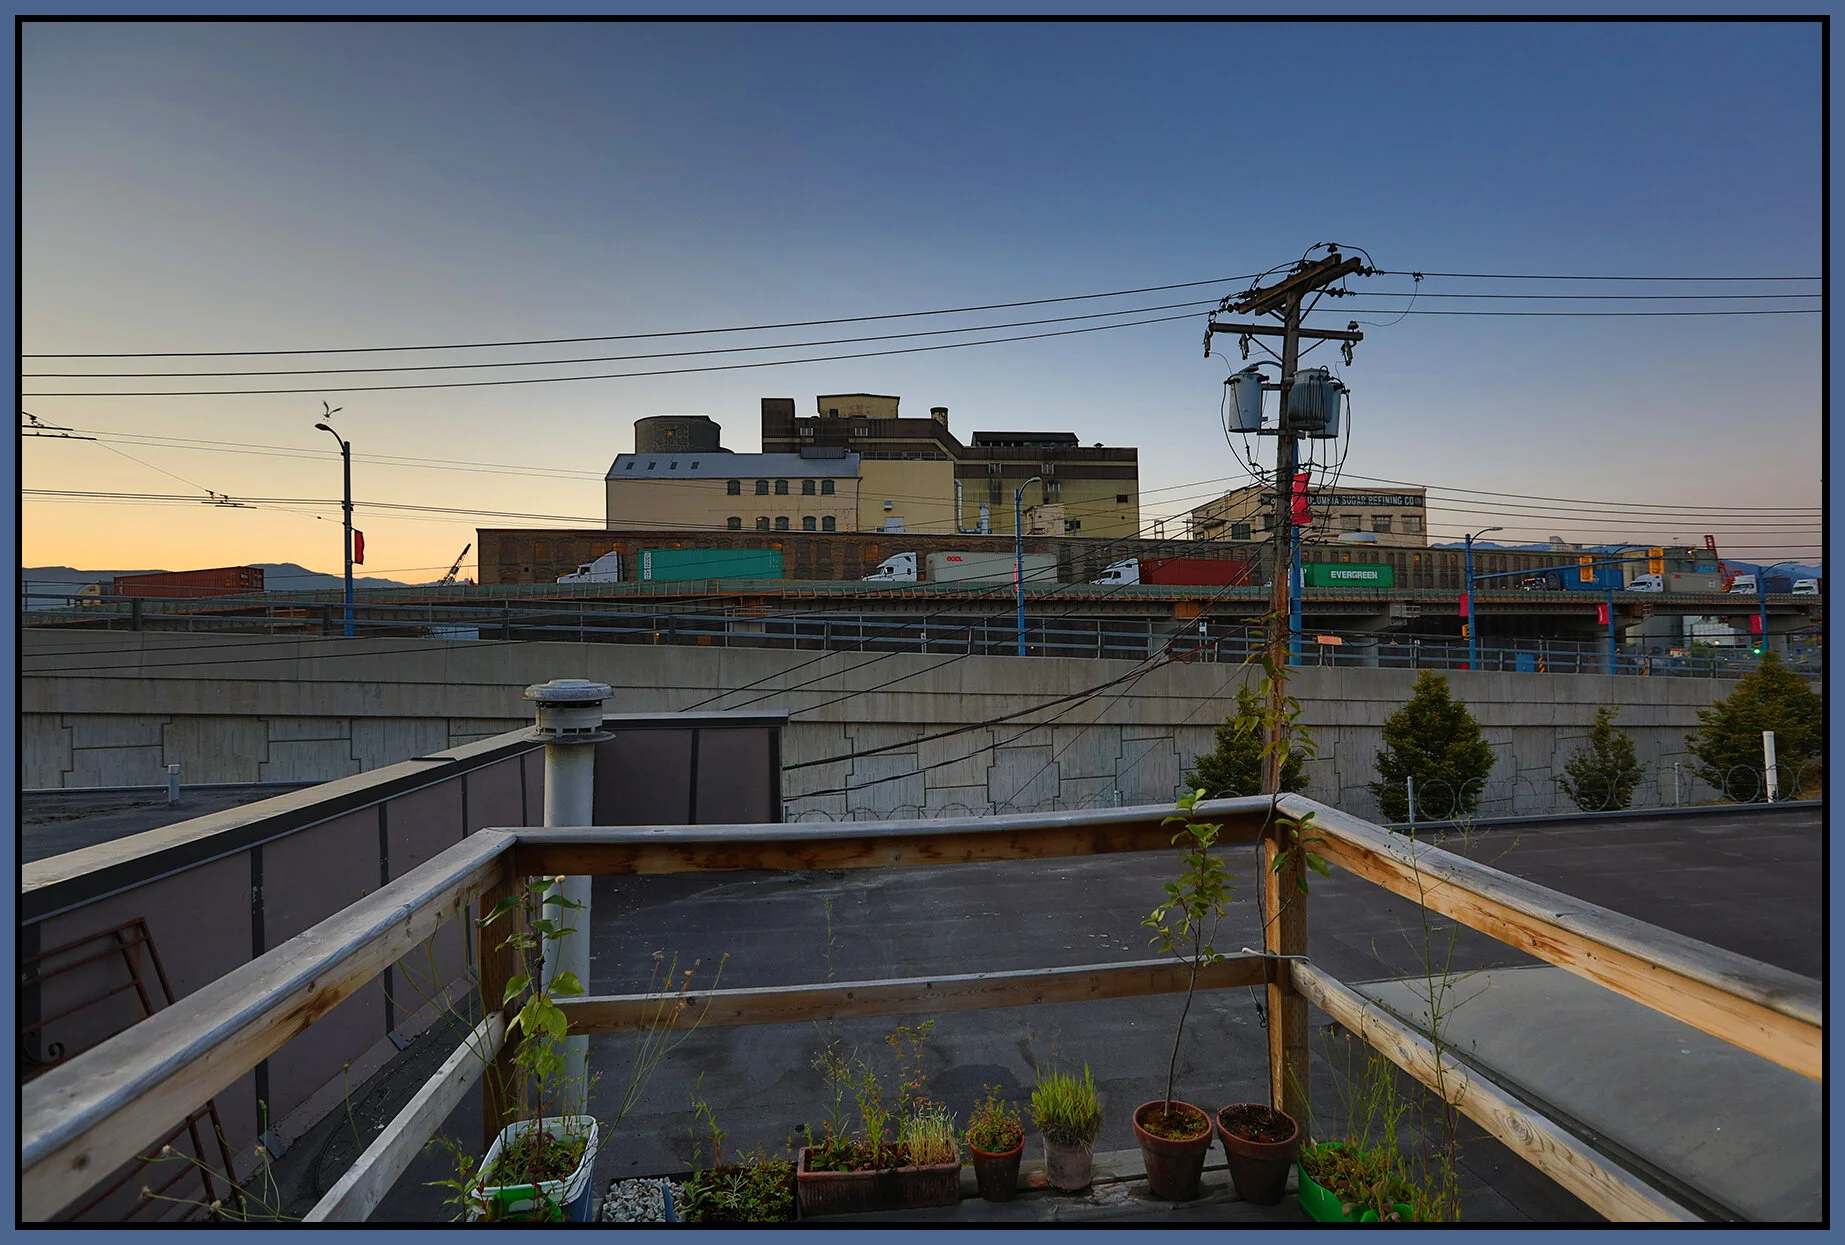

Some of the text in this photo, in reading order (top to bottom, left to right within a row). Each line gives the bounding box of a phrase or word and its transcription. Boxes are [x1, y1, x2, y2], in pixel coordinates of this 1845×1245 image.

[1307, 496, 1339, 505] OLUMBIA
[1342, 496, 1366, 505] SUGAR
[1368, 496, 1402, 505] REFINING
[1404, 496, 1414, 505] CO
[1330, 570, 1378, 579] EVERGREEN
